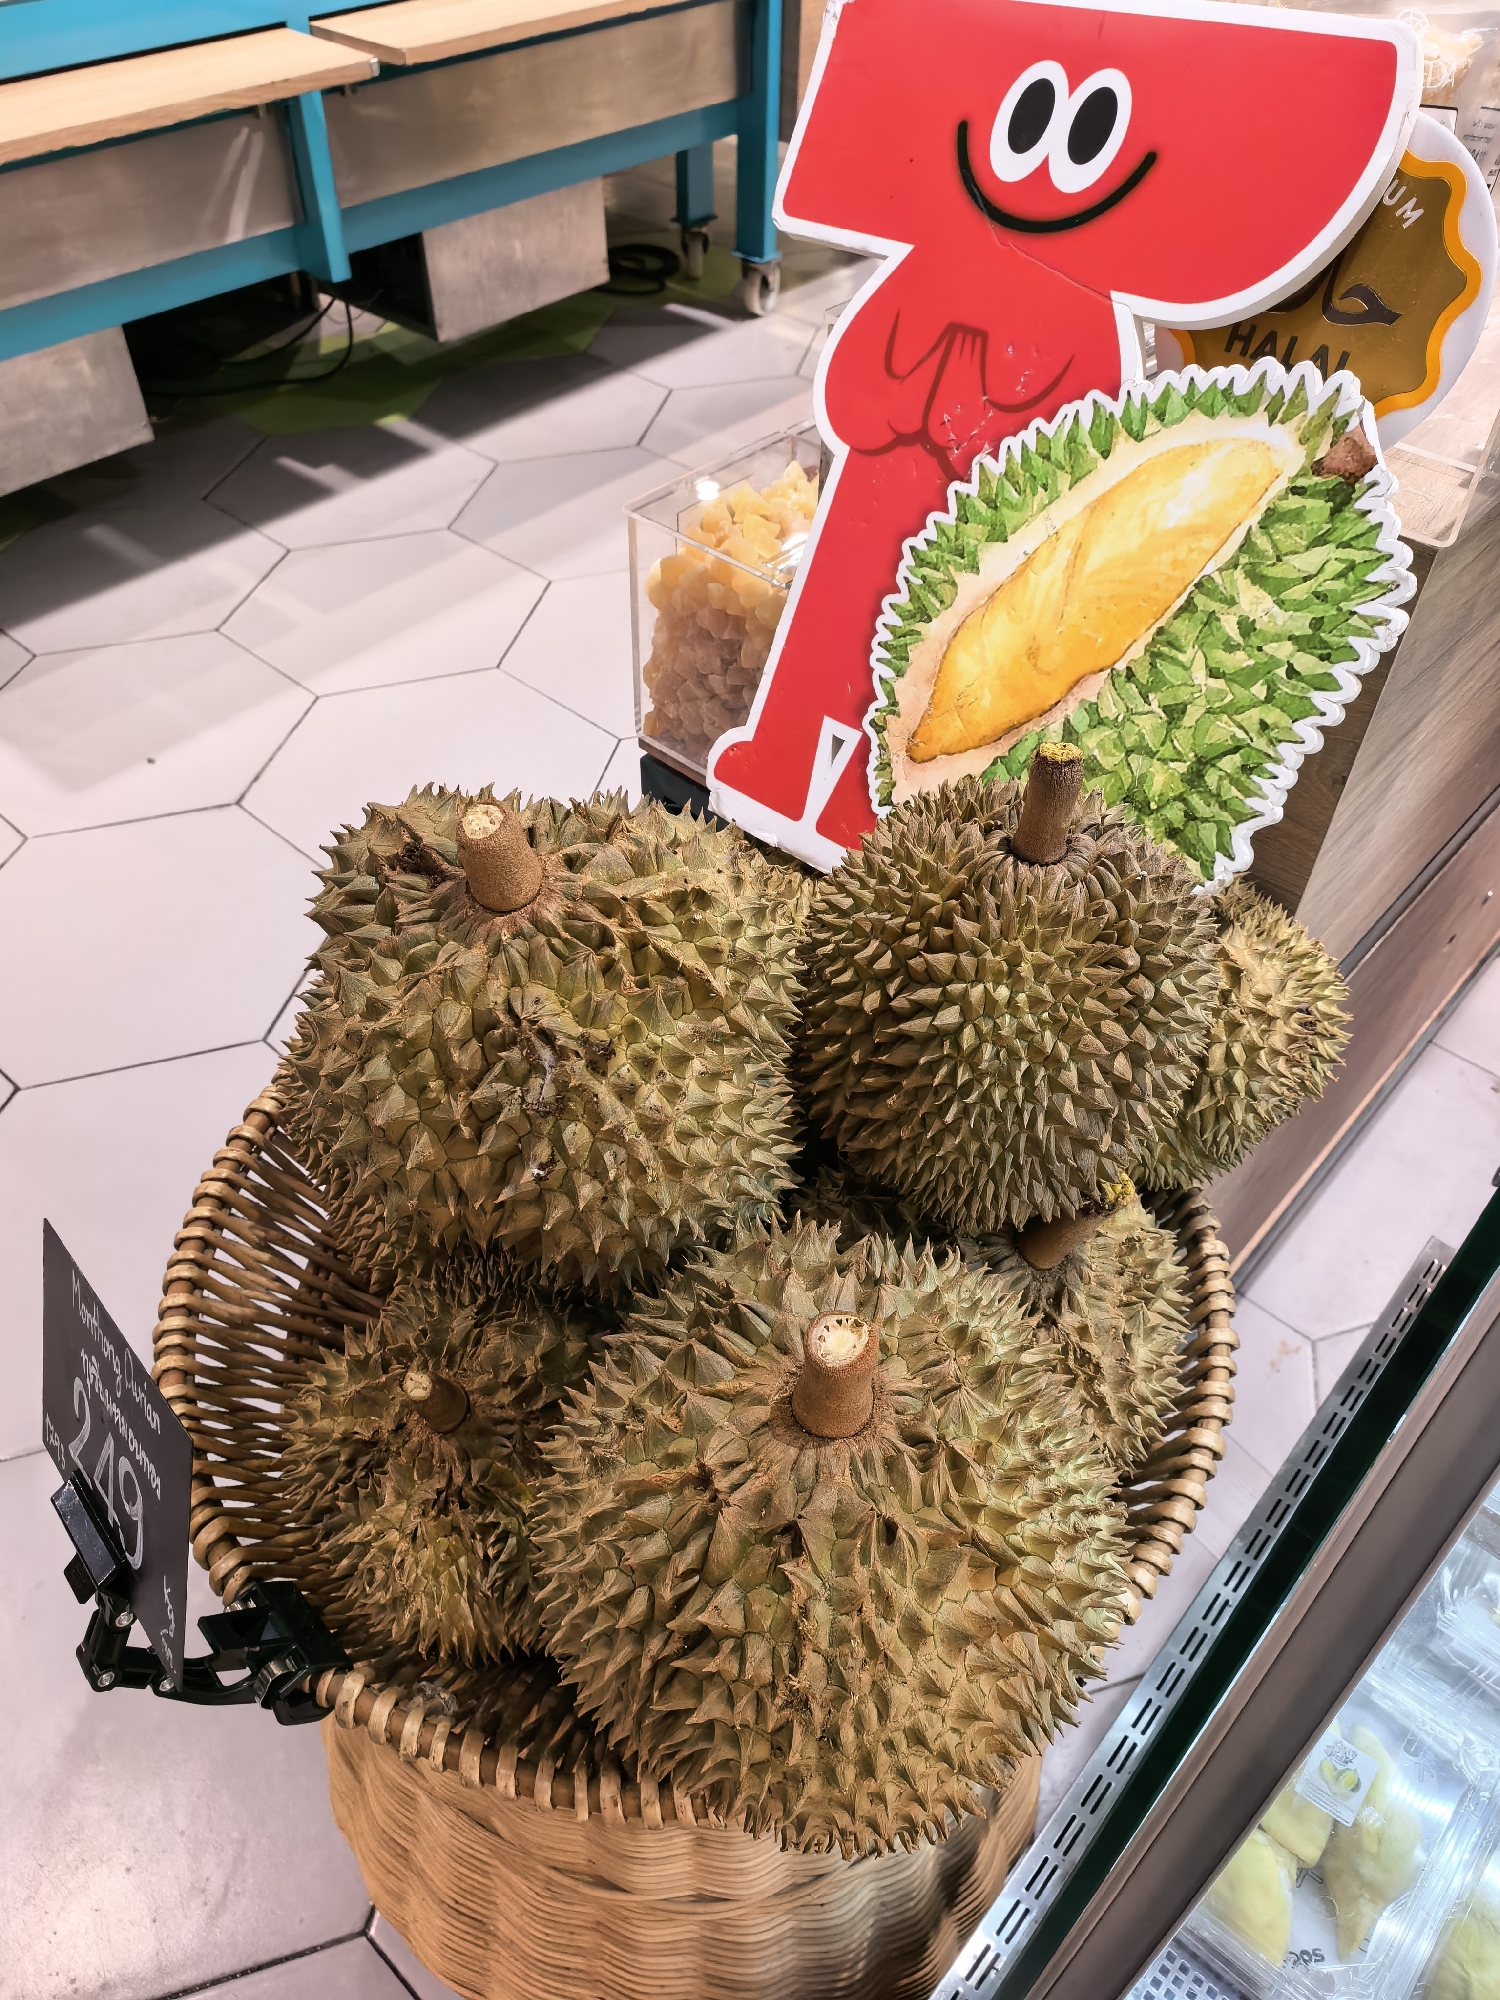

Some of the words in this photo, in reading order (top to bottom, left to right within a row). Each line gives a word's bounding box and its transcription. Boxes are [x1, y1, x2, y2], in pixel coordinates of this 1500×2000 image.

[72, 1268, 122, 1398] Monthong
[125, 1347, 161, 1435] Durian
[68, 1376, 143, 1570] 249
